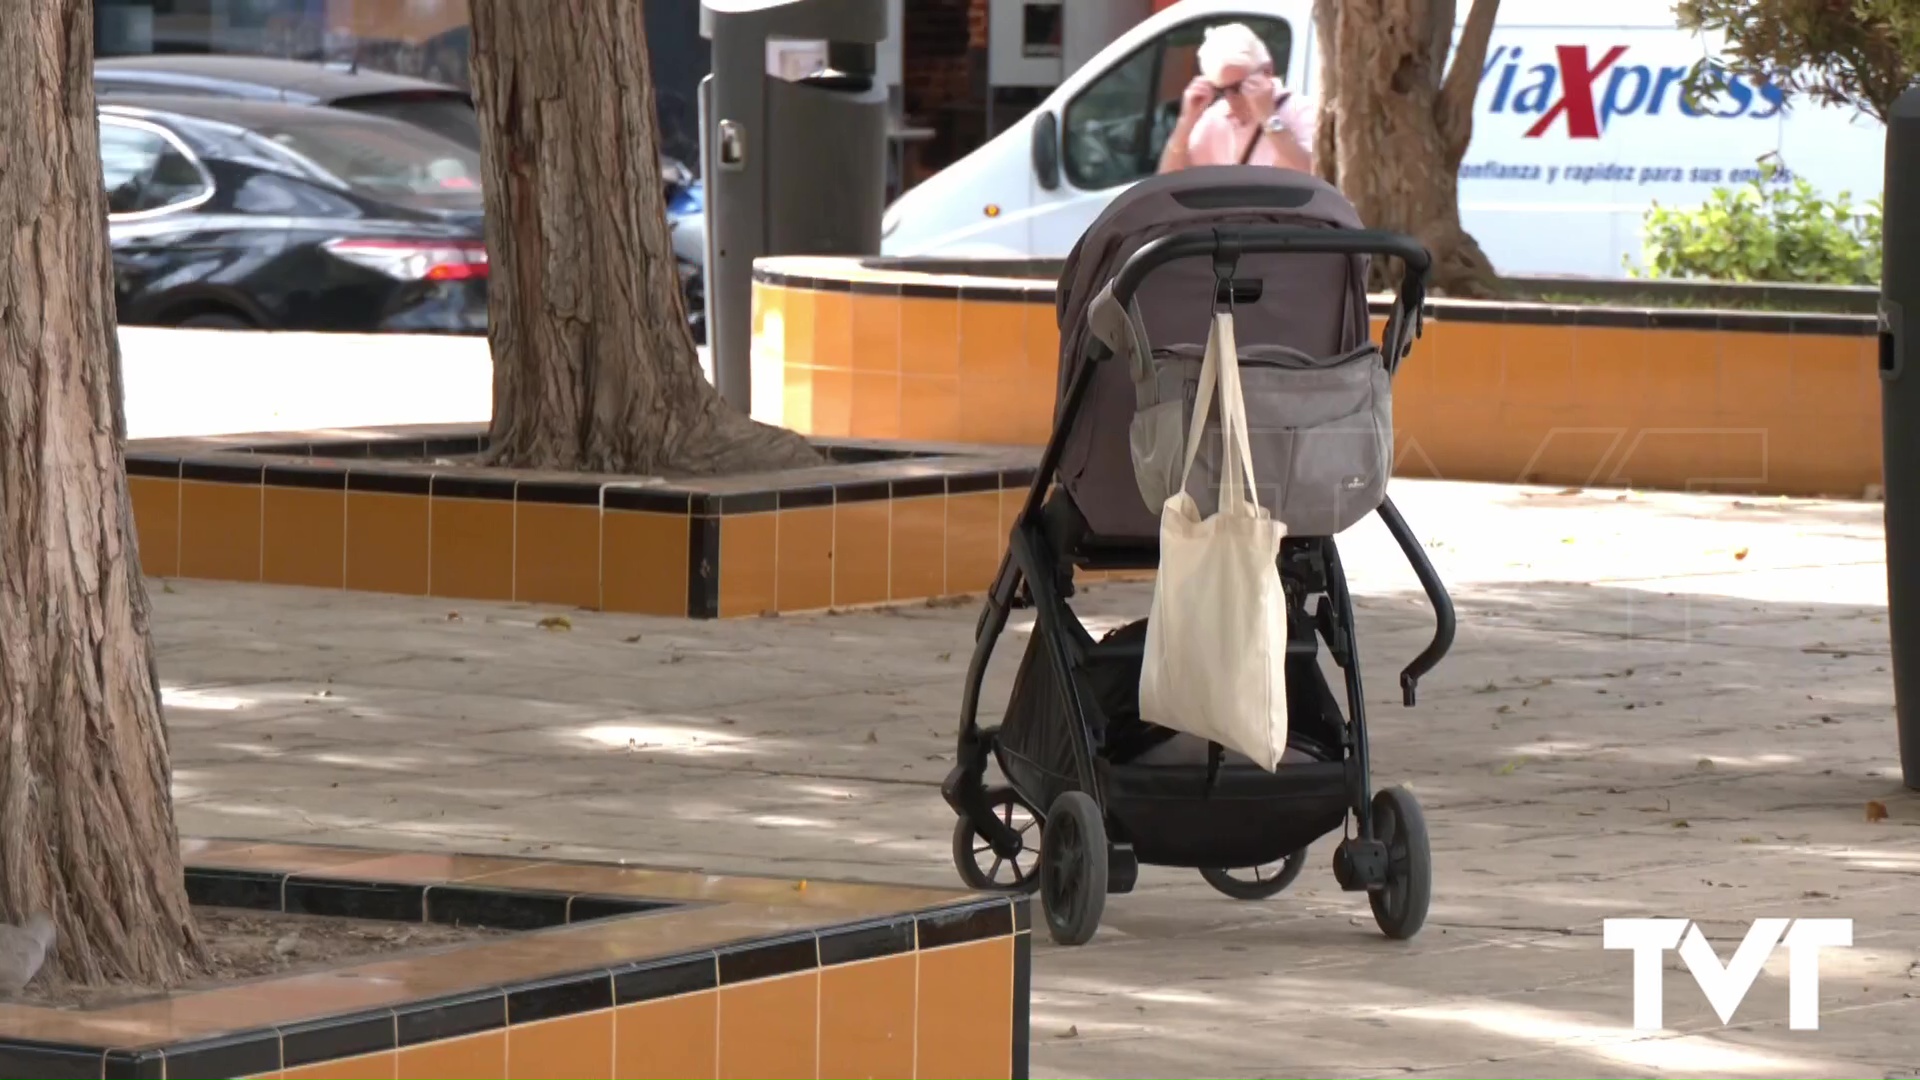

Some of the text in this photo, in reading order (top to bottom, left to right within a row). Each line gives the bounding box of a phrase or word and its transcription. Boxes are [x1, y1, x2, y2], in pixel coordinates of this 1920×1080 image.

[1459, 160, 1793, 185] onfianza y rapidez para sus envos
